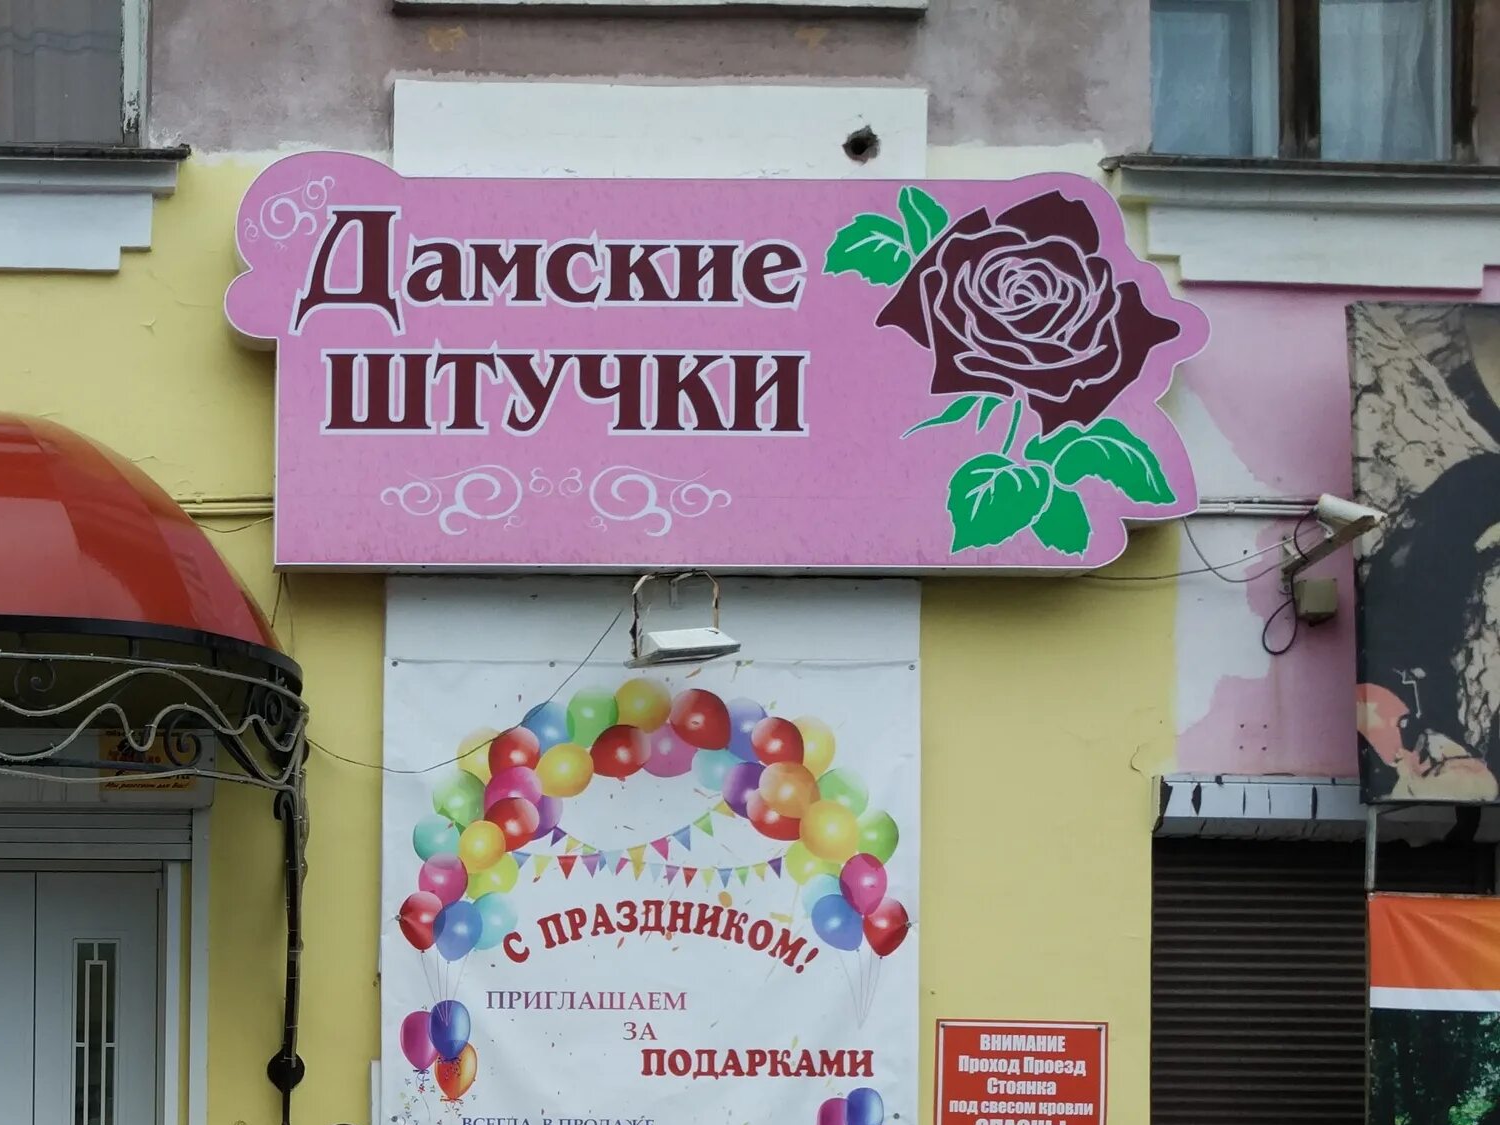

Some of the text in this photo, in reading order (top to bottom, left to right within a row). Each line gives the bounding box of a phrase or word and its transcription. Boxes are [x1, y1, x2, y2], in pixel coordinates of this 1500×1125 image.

[292, 207, 805, 333] Дамские
[502, 899, 820, 974] С ПРАЗДНИКОМ!
[486, 991, 688, 1011] ПРИГЛАШАЕМ
[622, 1022, 658, 1041] ЗА
[980, 1034, 1066, 1052] ВНИМАНИЕ
[640, 1048, 874, 1080] ПОДАРКАМИ
[958, 1055, 1086, 1076] Проход Проезд
[987, 1077, 1057, 1095] Стоянка
[949, 1100, 1093, 1116] под свесом кровли
